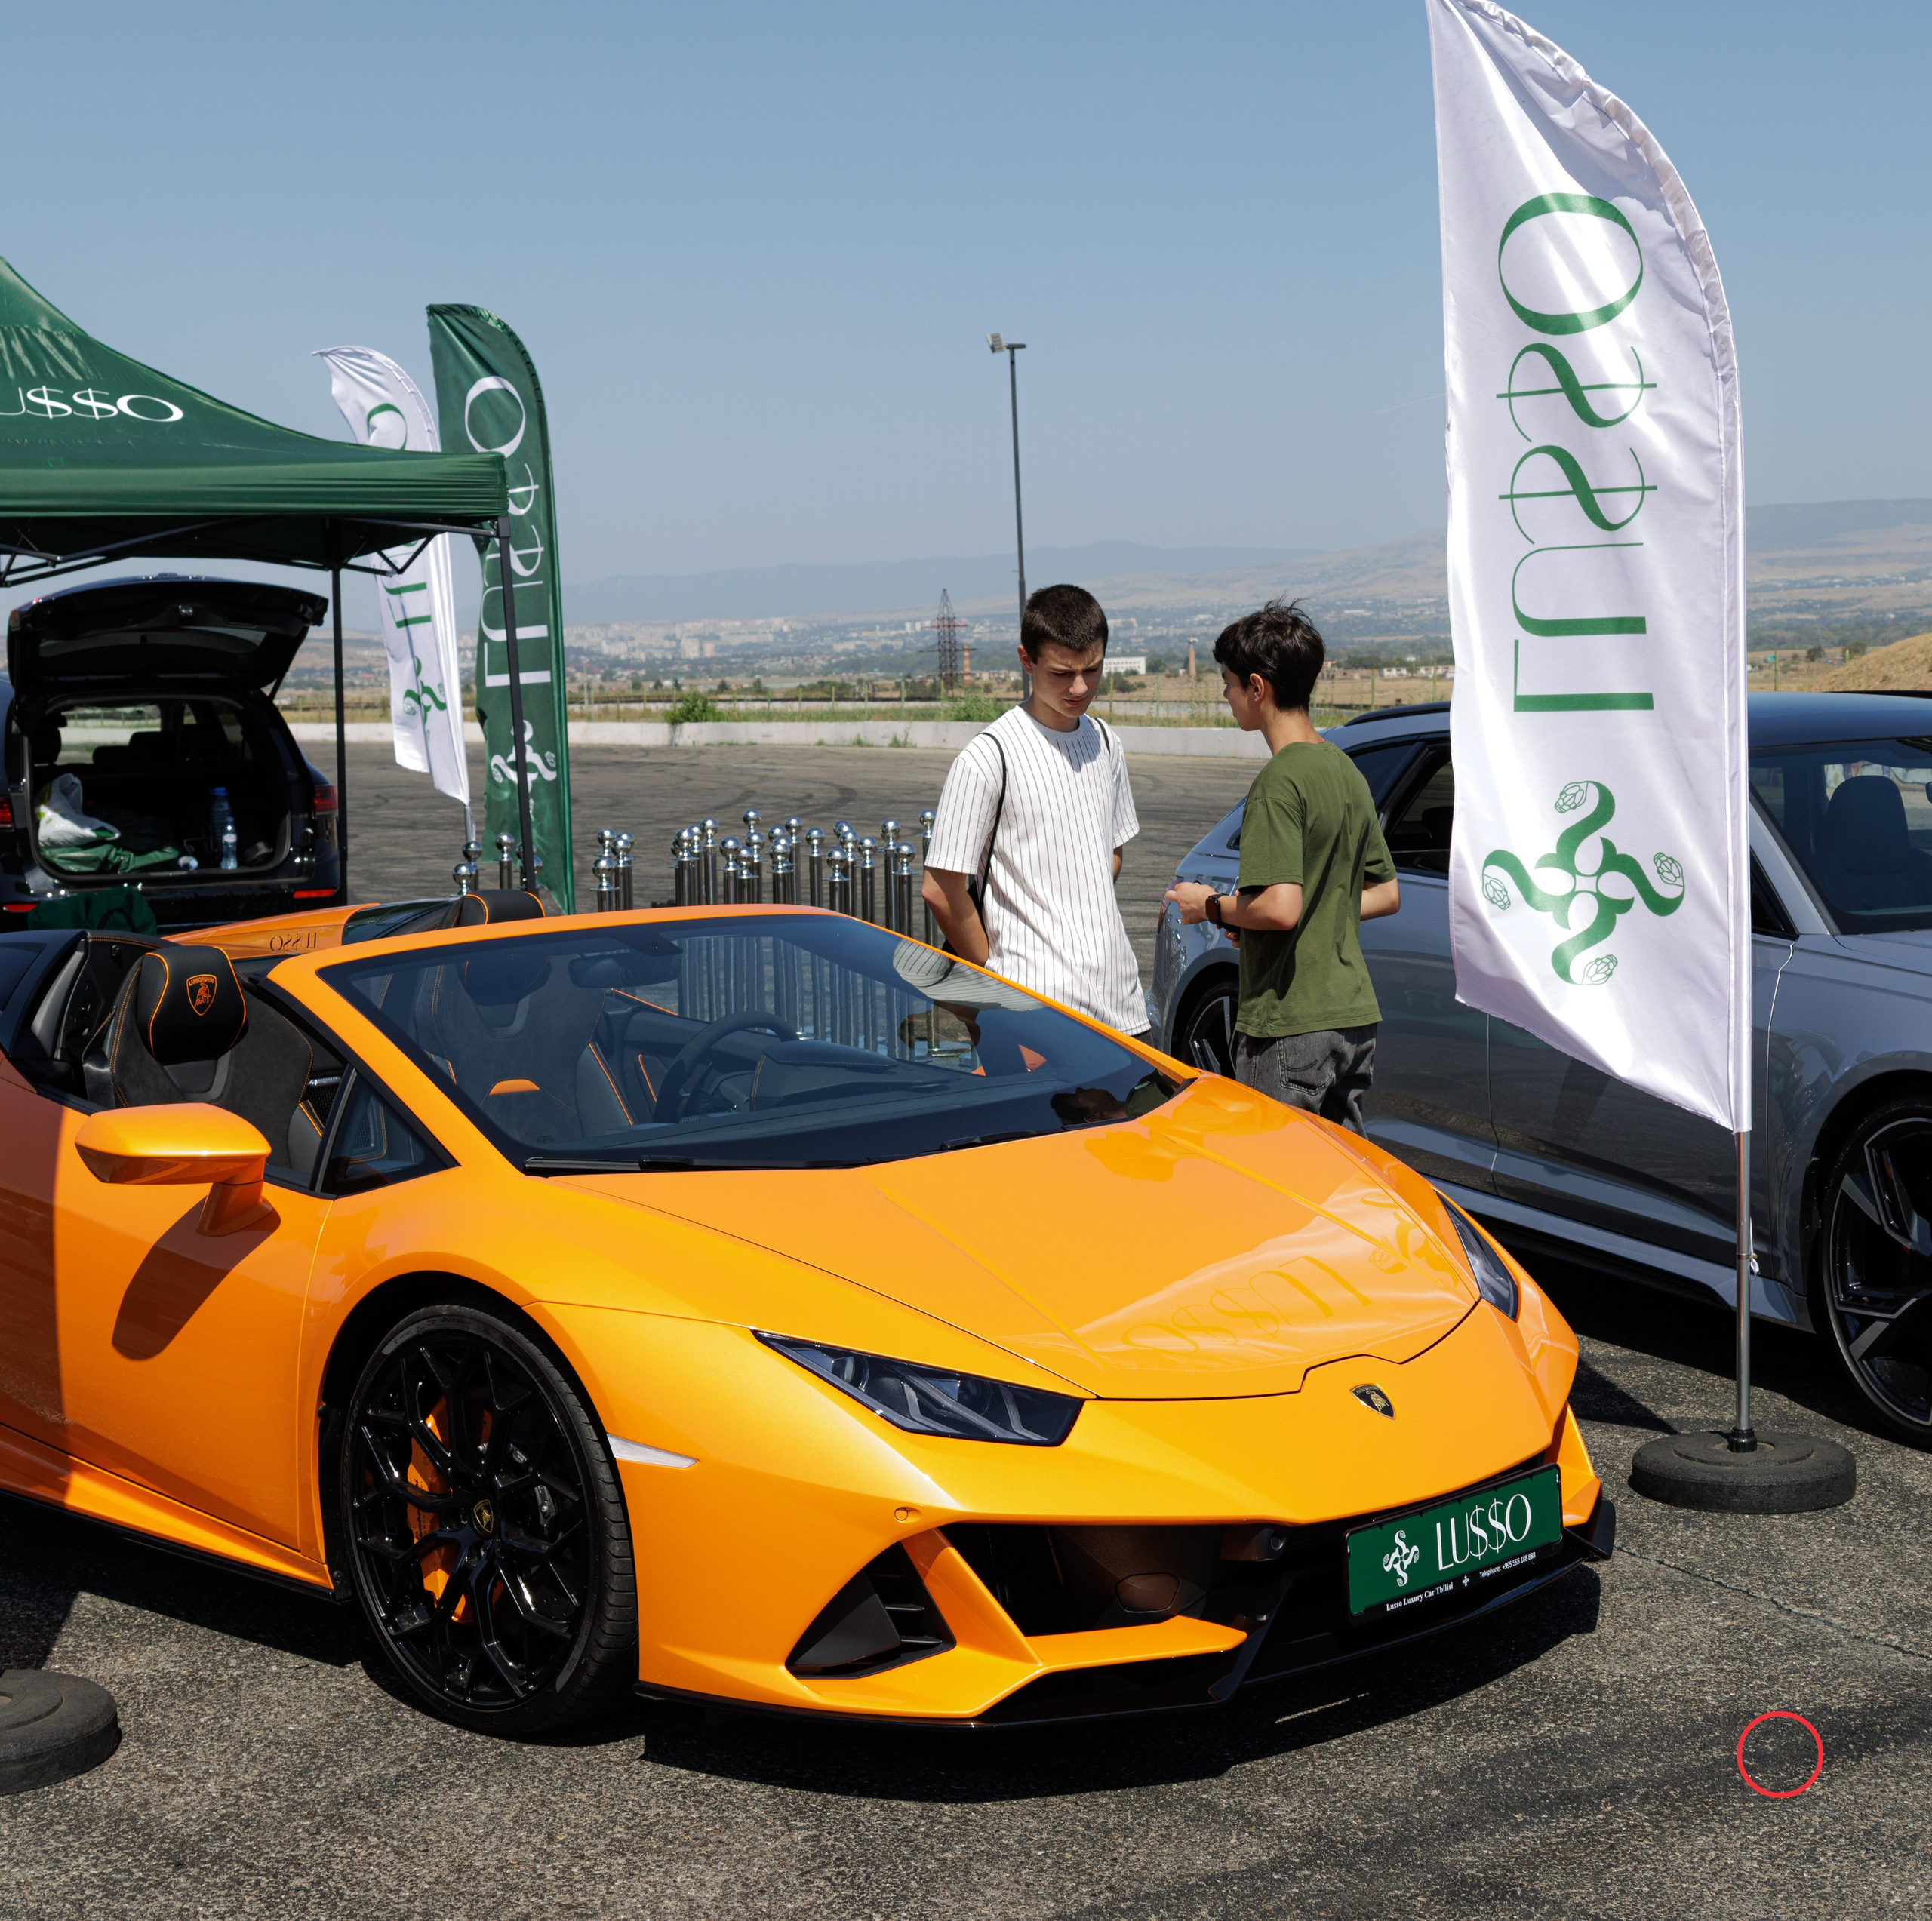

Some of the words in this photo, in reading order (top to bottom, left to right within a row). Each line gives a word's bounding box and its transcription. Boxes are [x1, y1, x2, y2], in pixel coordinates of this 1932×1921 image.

[1479, 1566, 1502, 1578] Telephone:
[1503, 1560, 1512, 1571] +995
[1512, 1557, 1521, 1567] 555
[1520, 1554, 1528, 1564] 188
[1386, 1600, 1402, 1612] Lusso
[1404, 1594, 1423, 1606] Luxury
[1424, 1590, 1435, 1599] Car
[1435, 1582, 1454, 1595] Tbilisi
